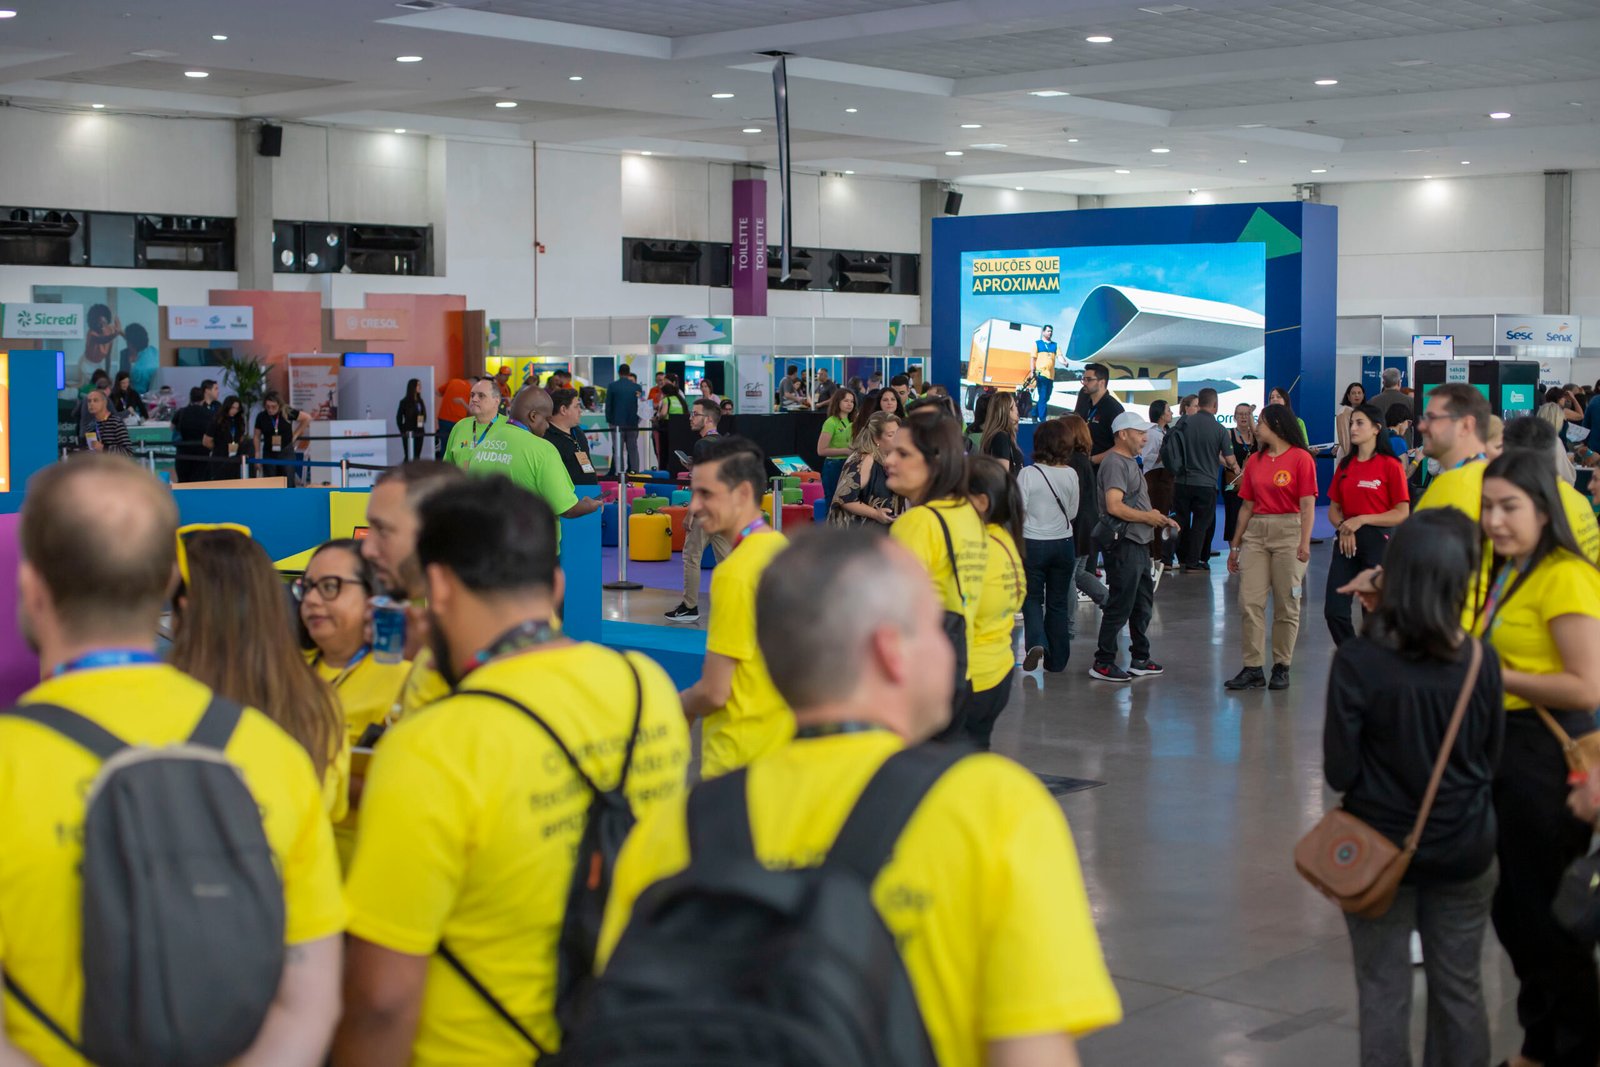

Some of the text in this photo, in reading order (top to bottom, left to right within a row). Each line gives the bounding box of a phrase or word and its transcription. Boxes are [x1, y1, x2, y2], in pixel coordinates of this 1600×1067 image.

[739, 217, 748, 271] TOILETTE
[756, 217, 764, 271] TOILETTE
[973, 259, 1059, 273] SOLUÇÕES QUE
[972, 277, 1060, 292] APROXIMAM
[34, 313, 78, 325] Sicredi
[360, 317, 400, 329] CRESOL
[1506, 330, 1533, 340] Sesc
[1546, 332, 1573, 342] Senac
